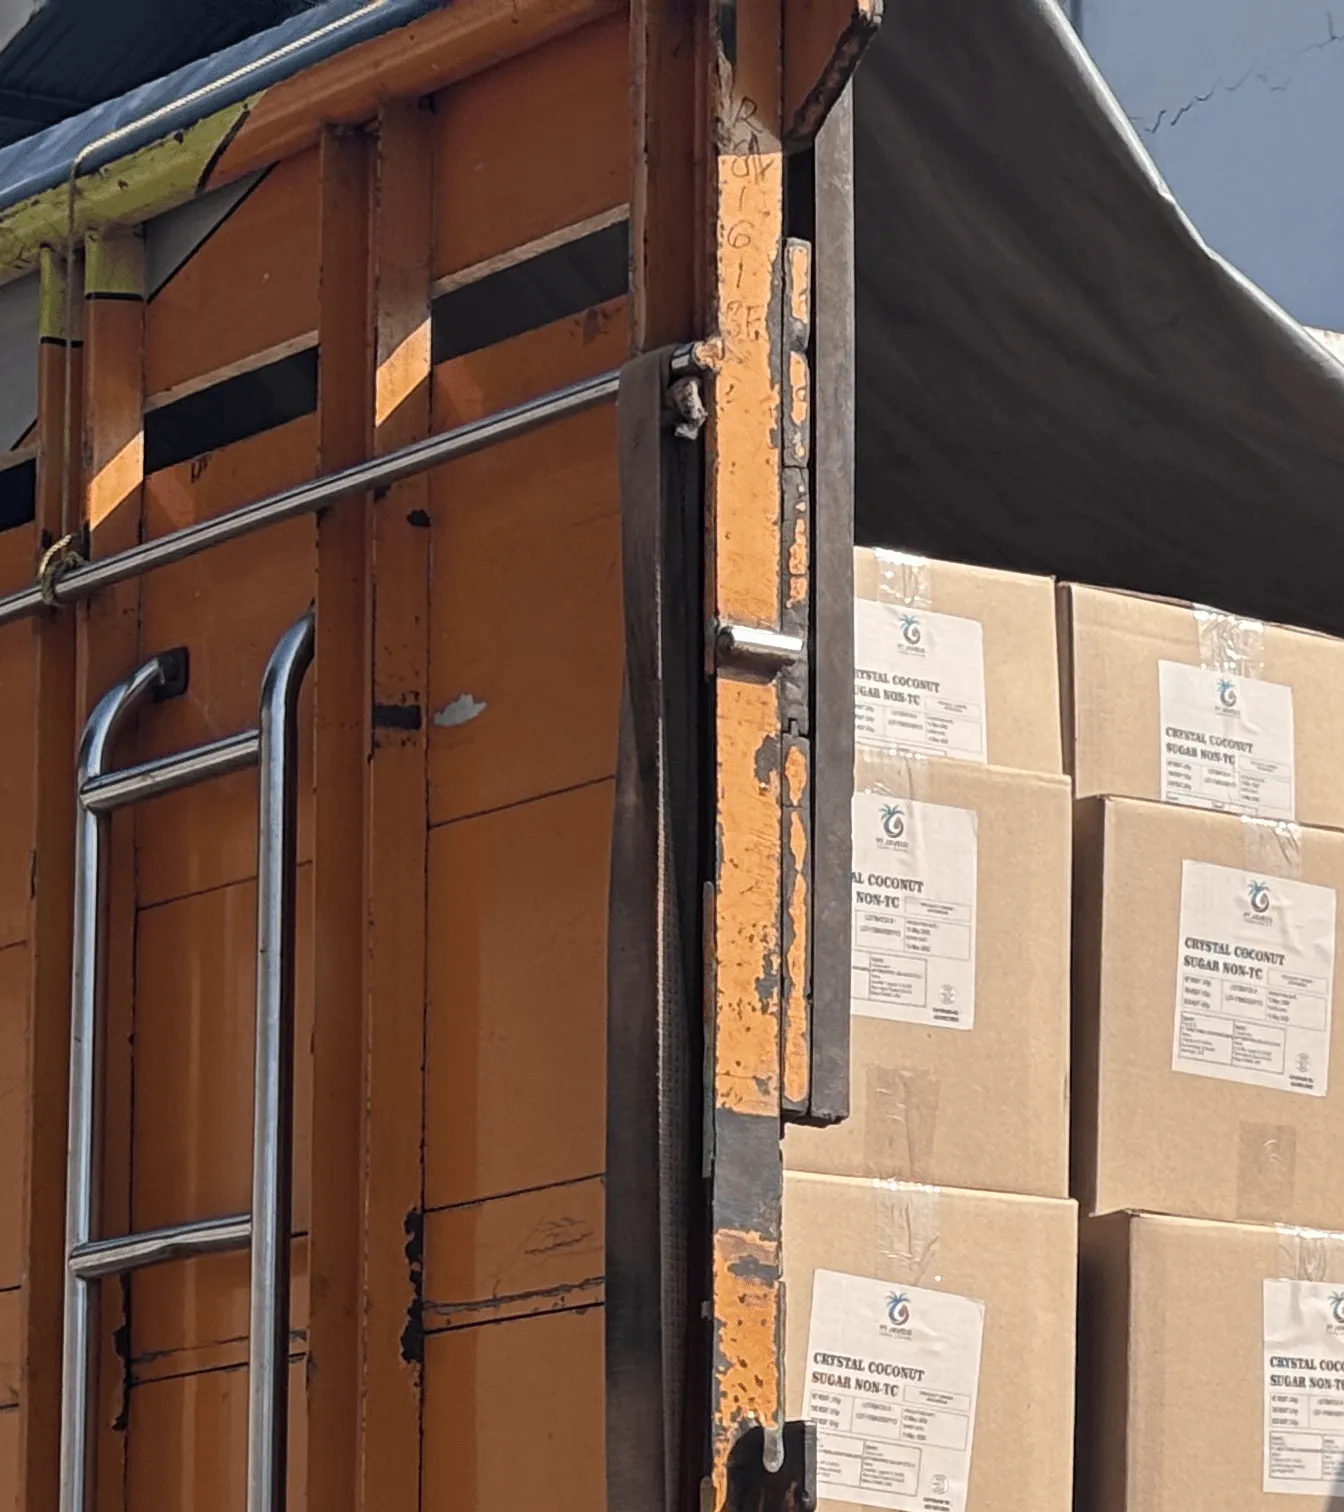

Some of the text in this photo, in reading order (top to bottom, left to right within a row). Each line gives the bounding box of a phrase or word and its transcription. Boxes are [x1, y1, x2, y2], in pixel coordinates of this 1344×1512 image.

[892, 675, 940, 693] COCONUT
[883, 689, 920, 705] NON-TC
[1165, 727, 1254, 753] CRYSTAL COCONUT
[1166, 742, 1198, 758] SUGAR
[868, 874, 924, 893] COCONUT
[856, 891, 900, 909] NON-TC
[1185, 937, 1285, 966] CRYSTAL COCONUT
[1184, 955, 1263, 980] SUGAR NON-TC
[814, 1352, 925, 1382] CRYSTAL COCONUT
[1270, 1356, 1317, 1370] CRYSTAL
[811, 1371, 899, 1397] SUGAR NON-TC
[1270, 1374, 1306, 1388] SUGAR
